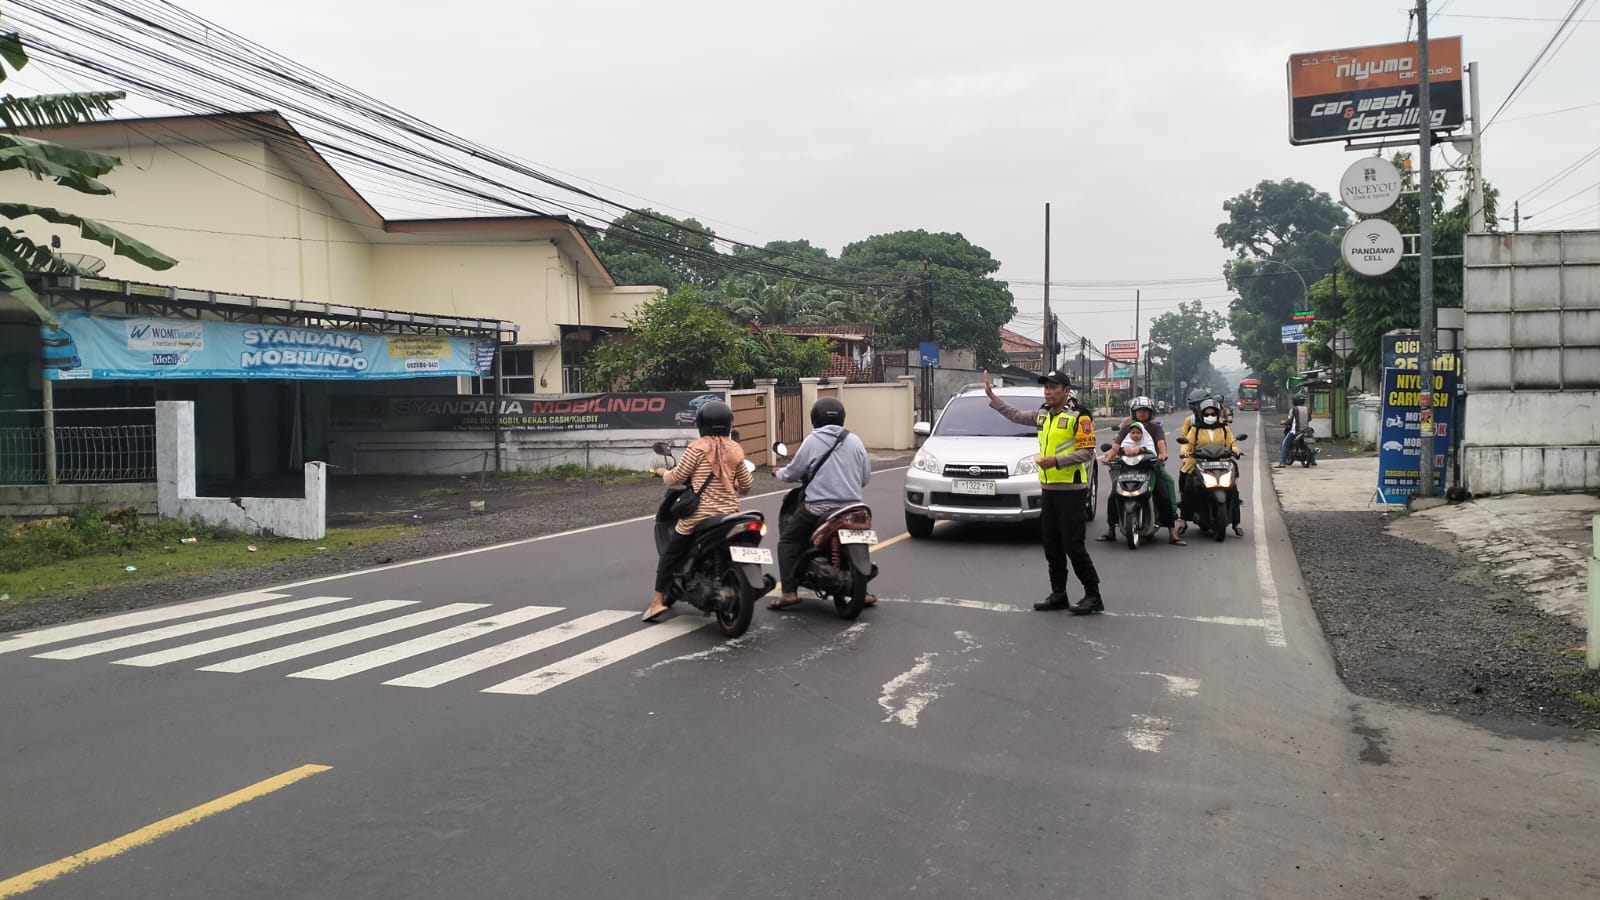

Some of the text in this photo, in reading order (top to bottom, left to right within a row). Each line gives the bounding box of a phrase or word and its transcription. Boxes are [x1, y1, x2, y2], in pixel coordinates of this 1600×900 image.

[1335, 56, 1413, 81] niyumo
[1399, 70, 1416, 79] car
[1310, 90, 1413, 117] car wash
[1343, 107, 1355, 118] &
[1347, 106, 1447, 131] detailig
[1345, 182, 1396, 196] NICEYOU
[1351, 247, 1395, 255] PANDAWA
[1363, 254, 1383, 262] CELL
[243, 328, 363, 352] SYANDANA
[1395, 341, 1420, 353] CUCI
[241, 350, 368, 371] MOBILINDO
[1396, 374, 1444, 390] NIYUO
[531, 397, 666, 415] MOBILINDO
[1388, 391, 1449, 408] CARWSH
[522, 416, 547, 424] BEKAS
[953, 481, 959, 489] R
[965, 481, 981, 490] 1322
